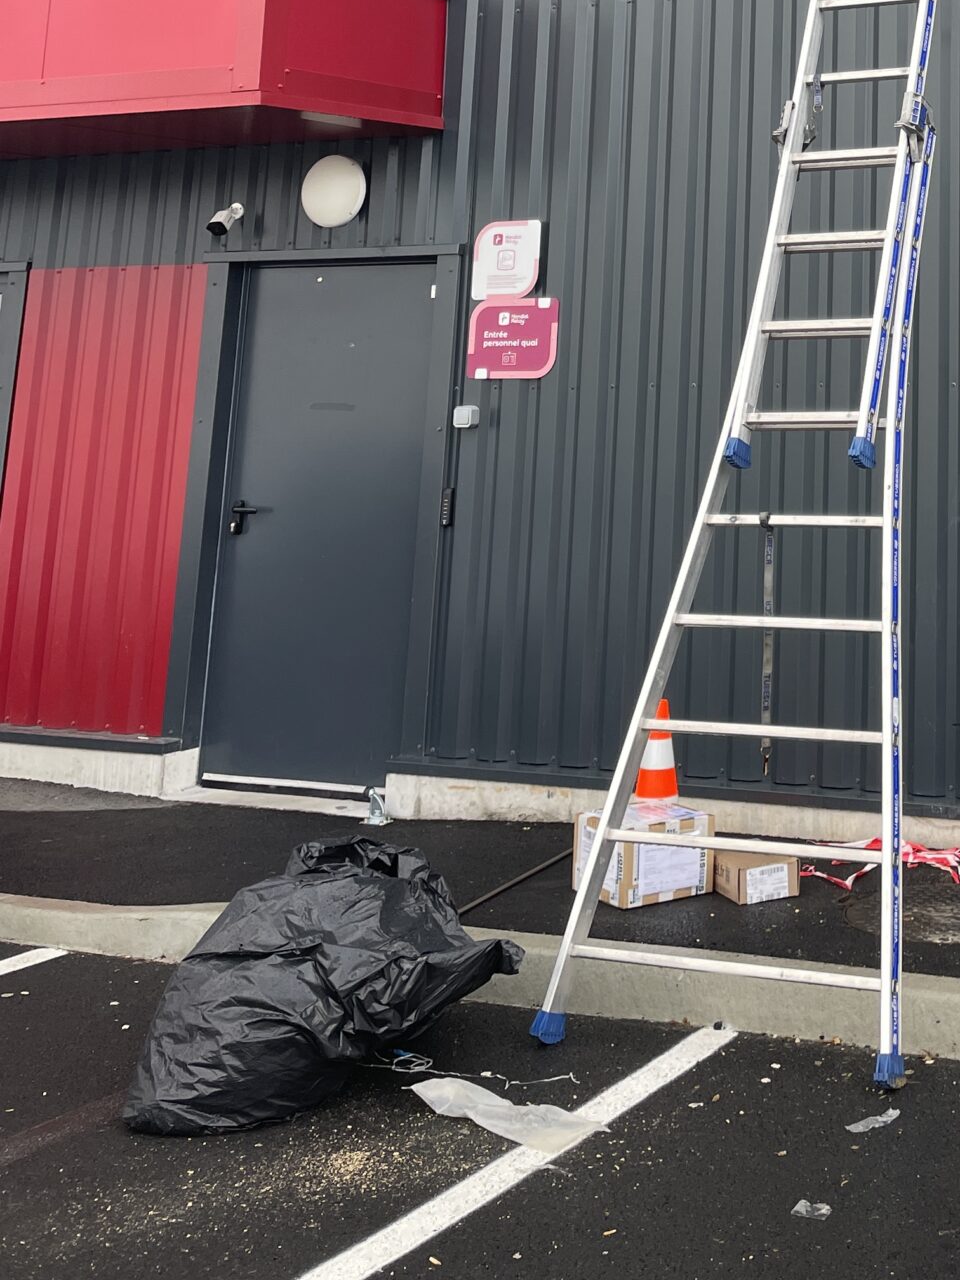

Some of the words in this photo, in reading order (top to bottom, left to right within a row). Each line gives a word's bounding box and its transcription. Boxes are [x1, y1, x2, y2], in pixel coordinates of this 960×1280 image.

[483, 330, 508, 339] Entrée
[482, 339, 520, 349] personnel
[520, 338, 538, 348] quai
